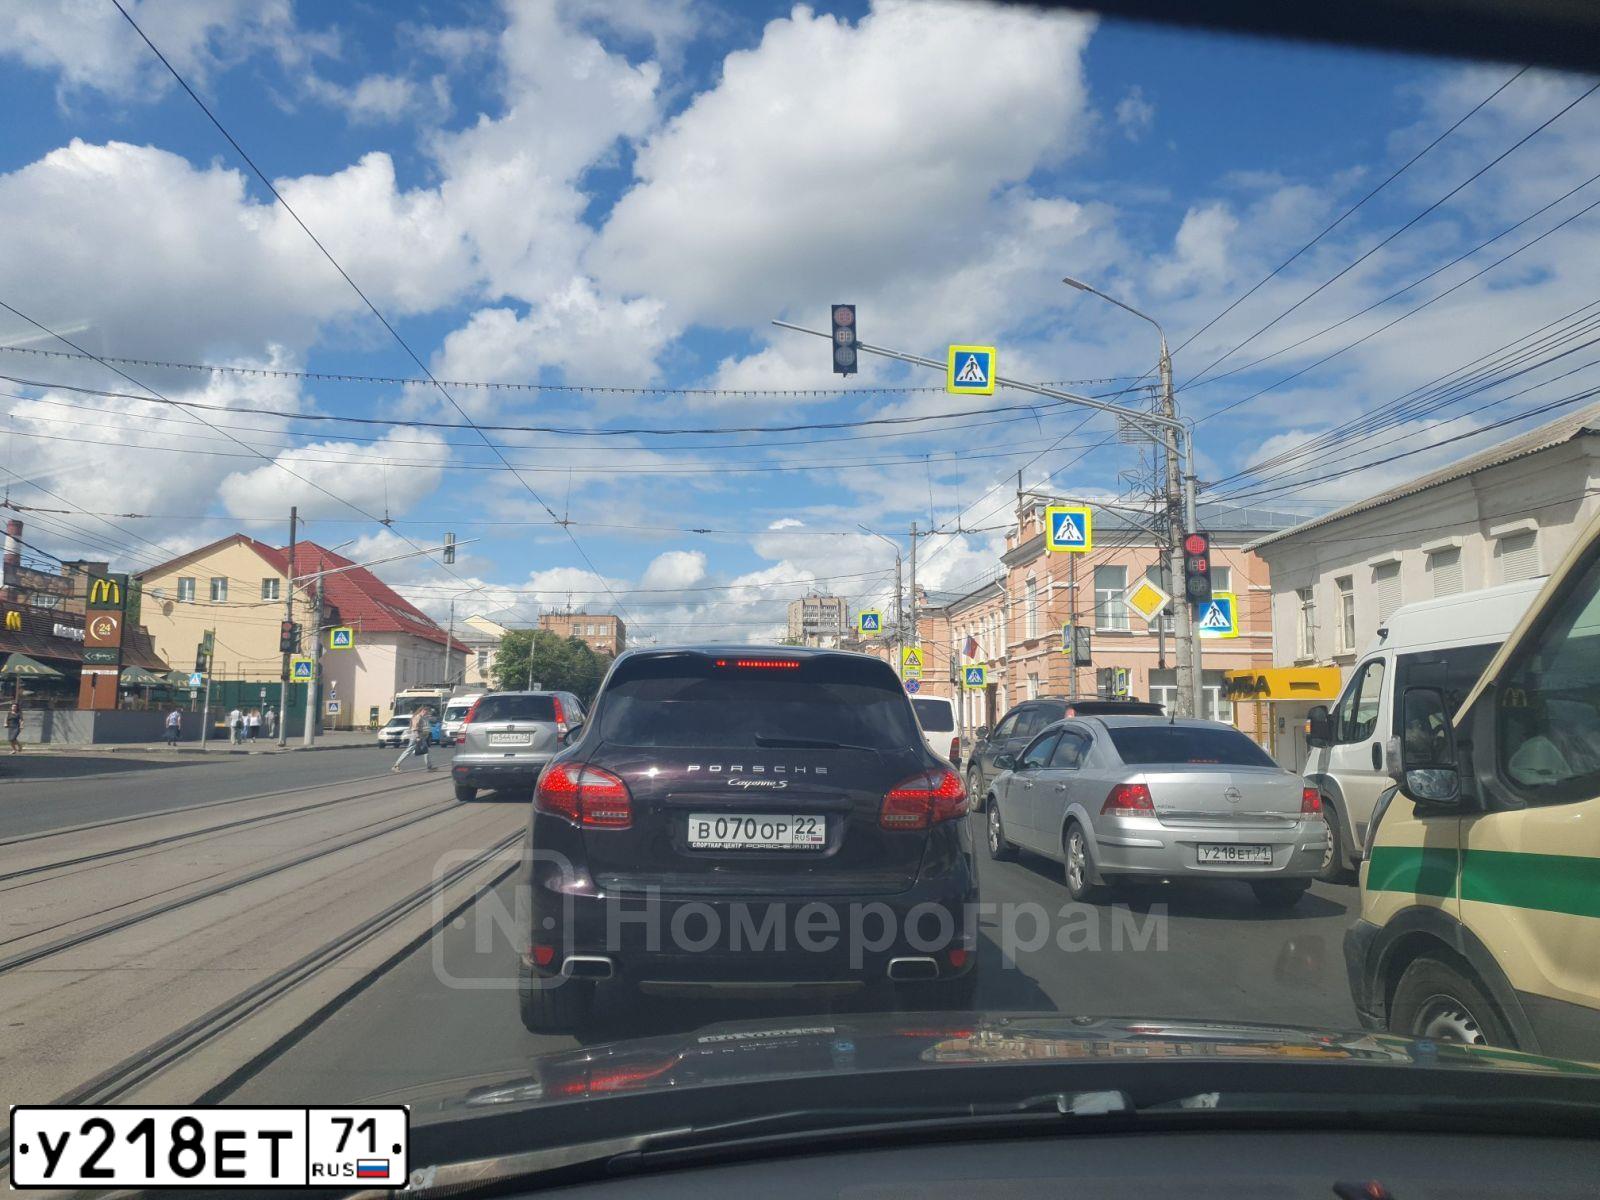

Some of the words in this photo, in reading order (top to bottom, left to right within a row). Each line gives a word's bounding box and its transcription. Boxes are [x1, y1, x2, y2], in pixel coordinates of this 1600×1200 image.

[98, 623, 111, 632] 24
[687, 765, 828, 774] PORSCHE
[728, 778, 775, 788] Cayenne
[698, 817, 787, 840] В070ОР
[795, 817, 817, 834] 22
[1203, 846, 1252, 860] У218ЕТ
[1256, 847, 1267, 857] 71
